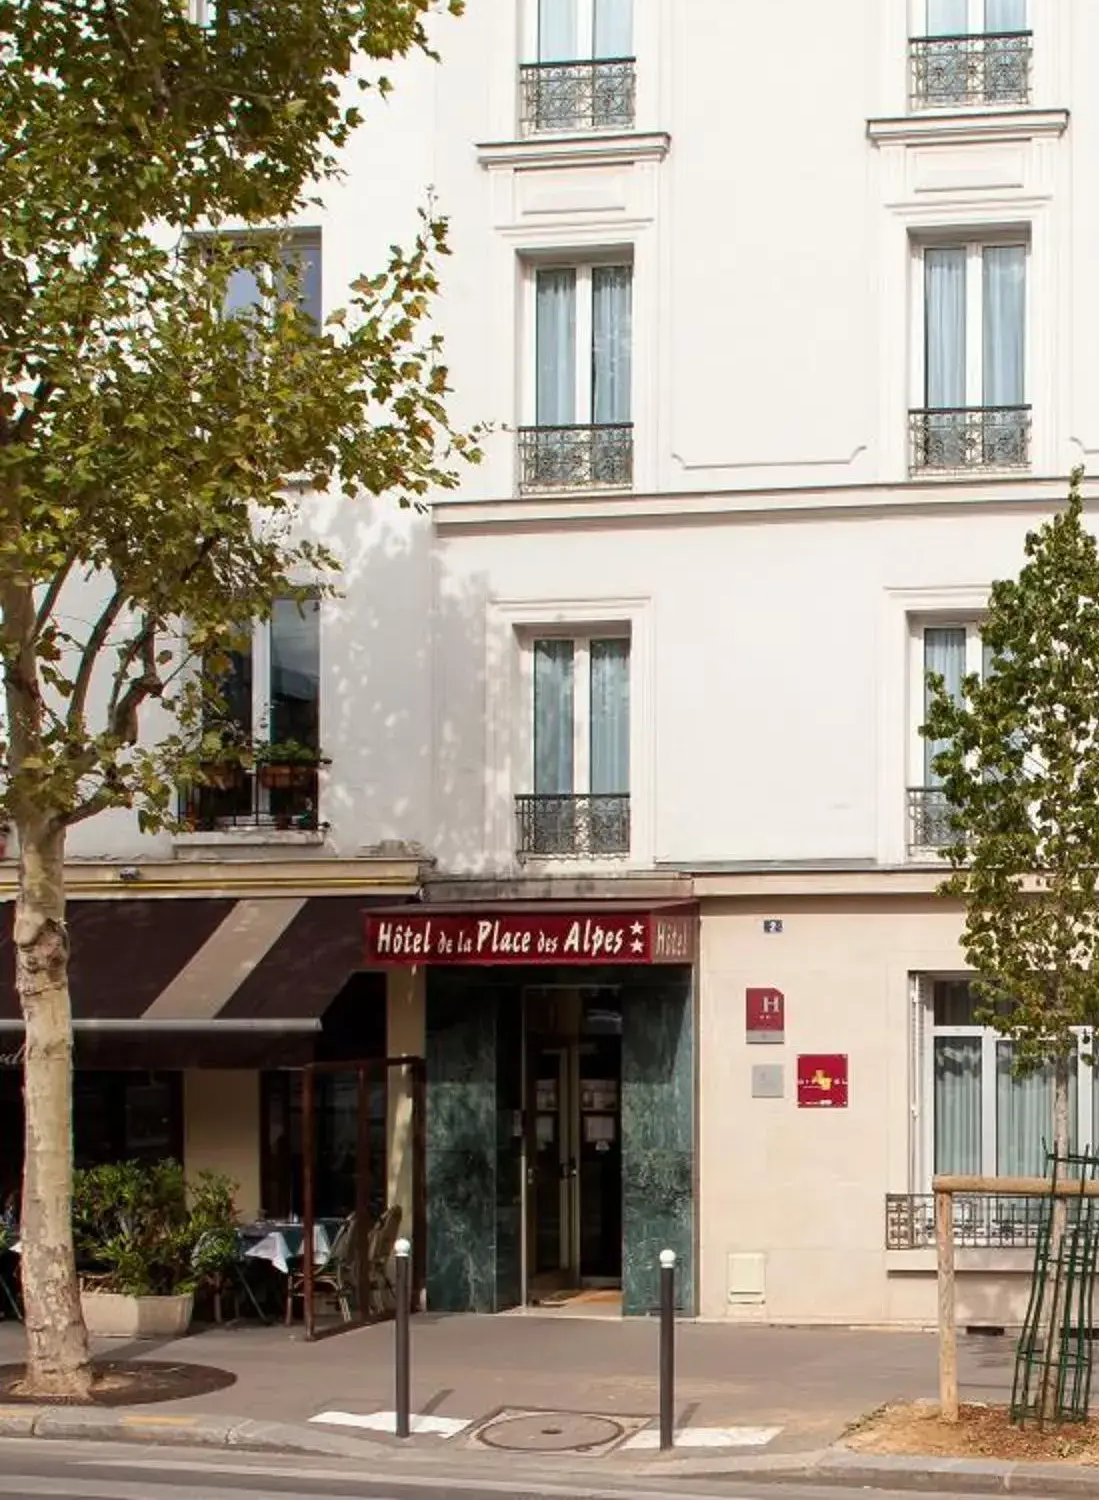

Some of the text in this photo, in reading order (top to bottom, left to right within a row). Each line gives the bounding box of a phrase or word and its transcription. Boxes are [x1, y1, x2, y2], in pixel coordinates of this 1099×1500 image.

[377, 919, 624, 957] Hôtel de la Place des Alpes
[763, 996, 779, 1013] H
